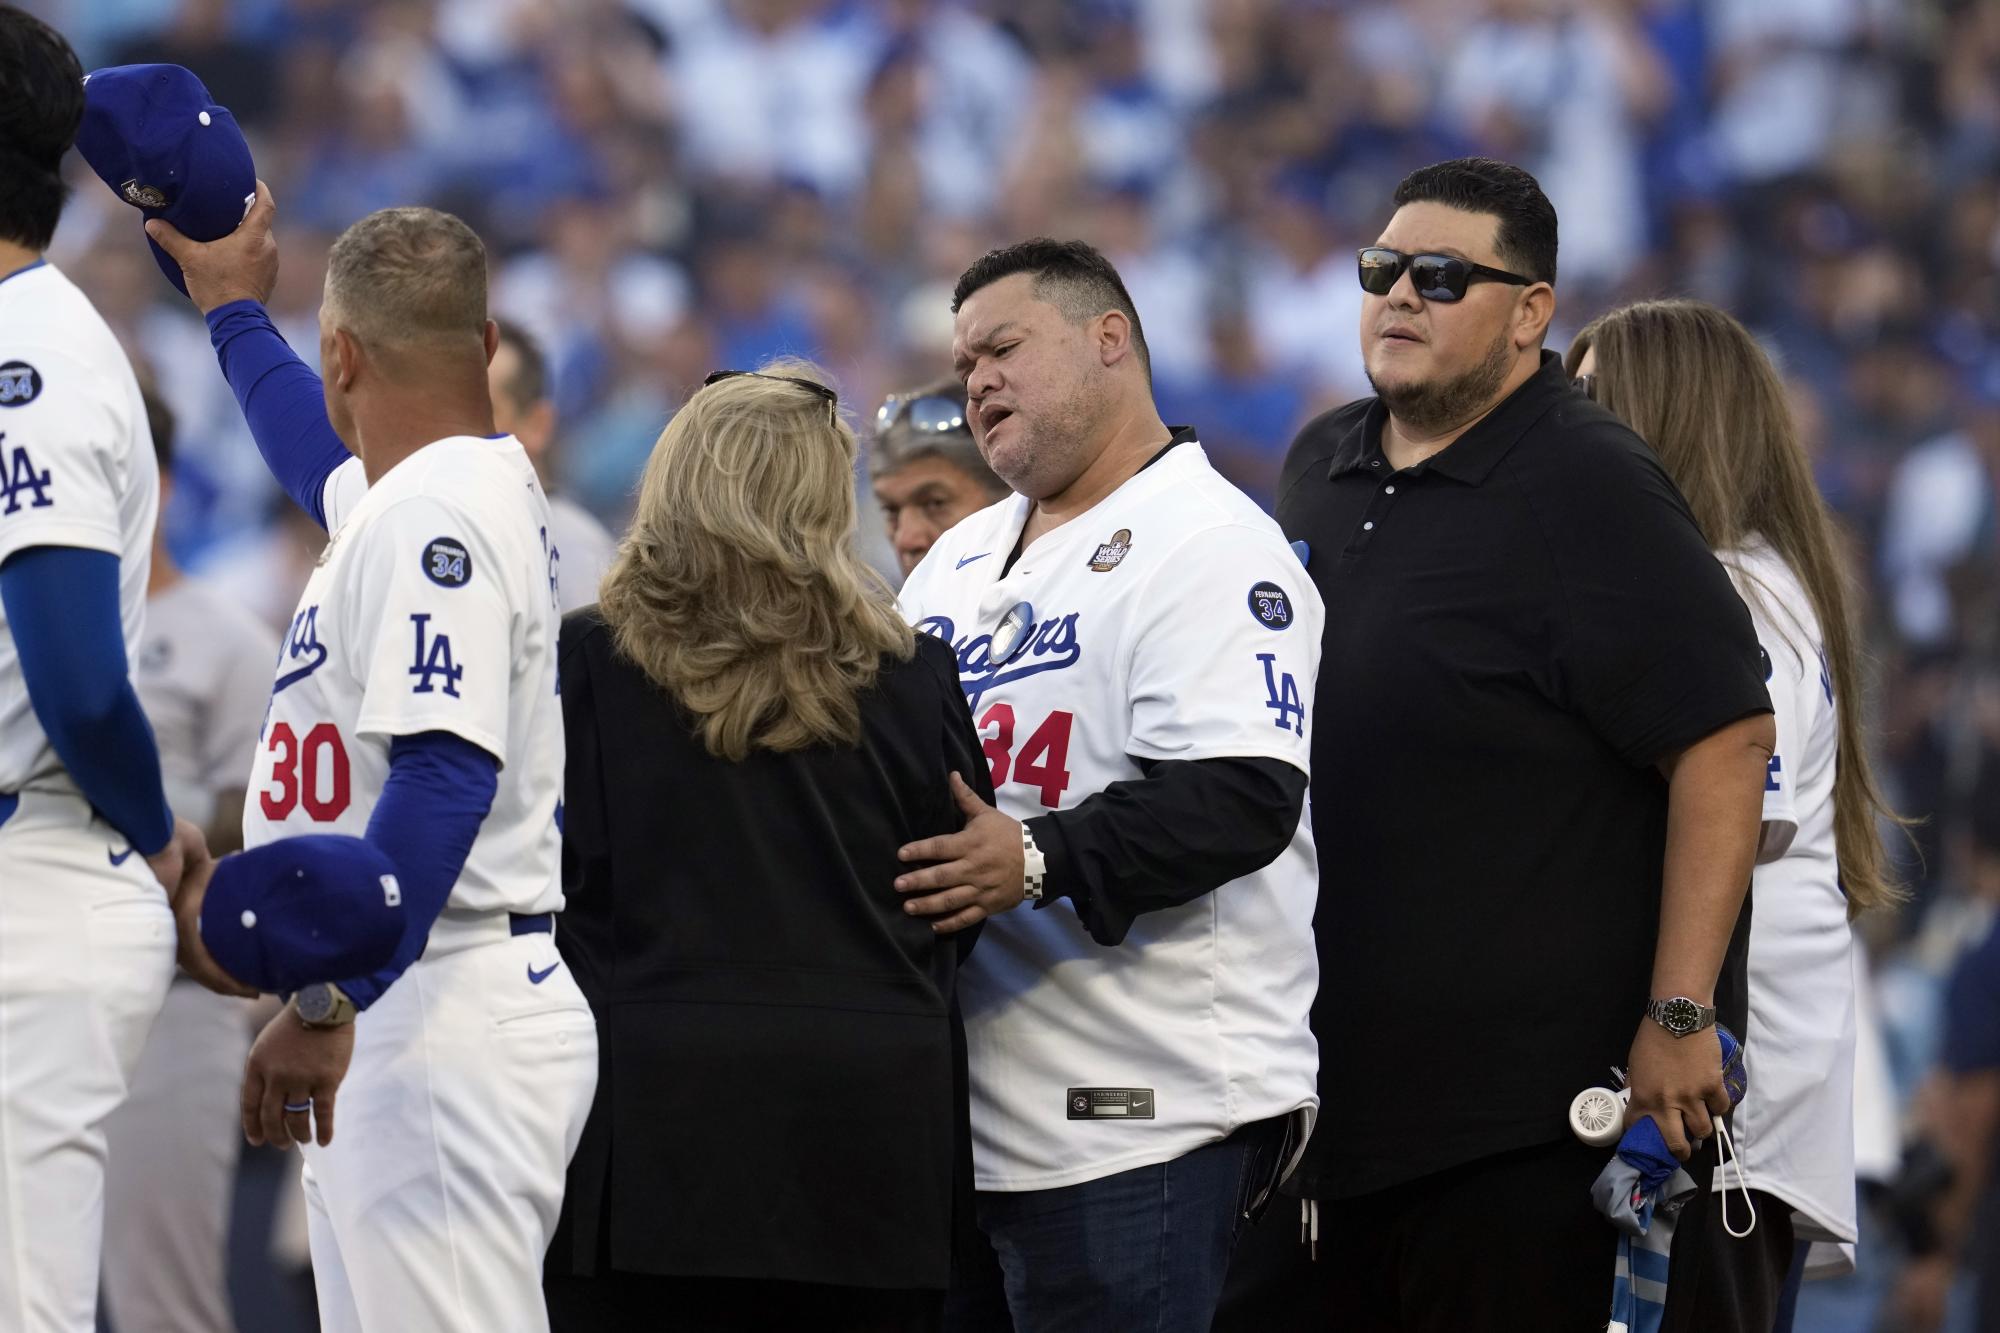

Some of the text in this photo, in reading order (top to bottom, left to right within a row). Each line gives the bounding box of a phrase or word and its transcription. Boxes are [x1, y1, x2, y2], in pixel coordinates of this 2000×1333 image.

[1093, 554, 1121, 563] SERIES
[1097, 546, 1128, 556] WORLD
[431, 553, 464, 582] 34
[1254, 590, 1284, 599] FERNANDO
[1258, 598, 1287, 621] 34
[409, 613, 463, 699] LA
[1255, 653, 1305, 739] LA
[976, 702, 1073, 809] 34
[260, 722, 351, 822] 30
